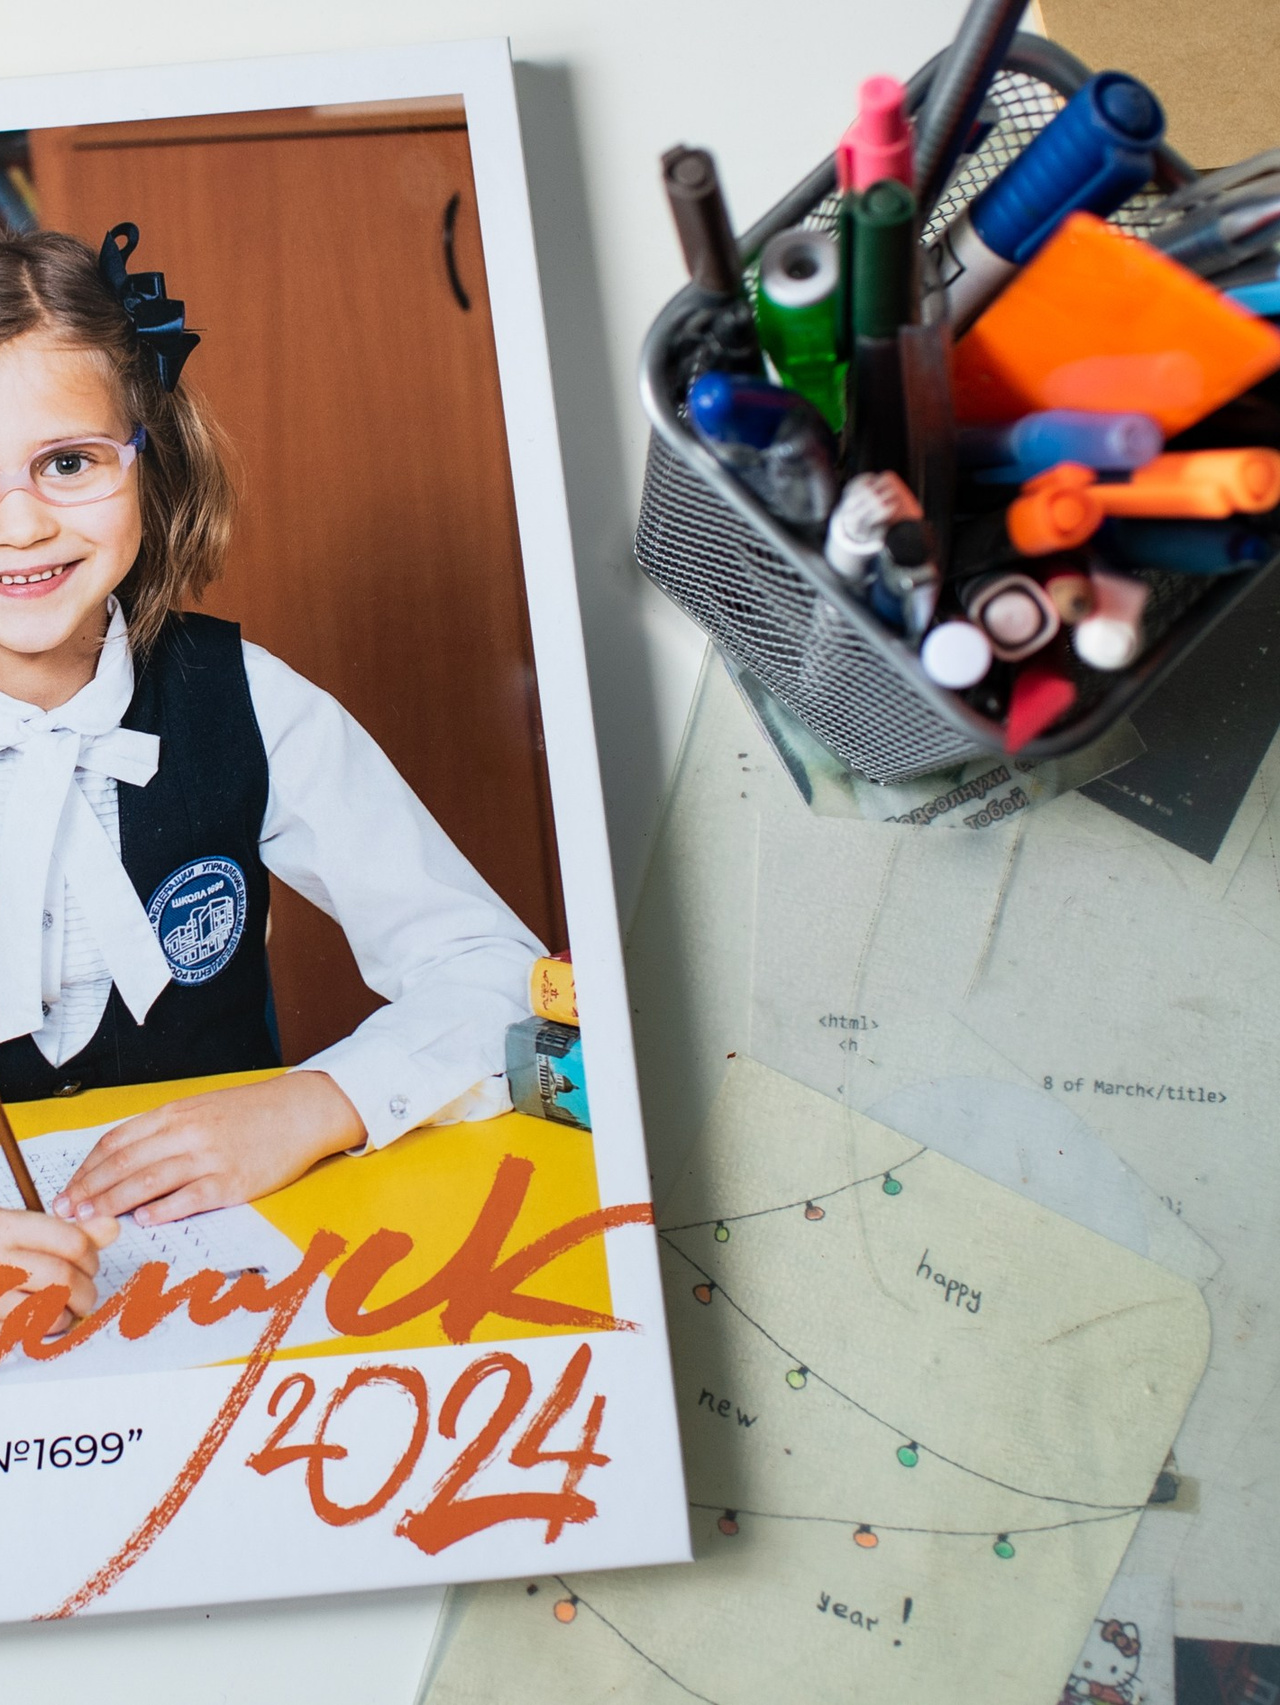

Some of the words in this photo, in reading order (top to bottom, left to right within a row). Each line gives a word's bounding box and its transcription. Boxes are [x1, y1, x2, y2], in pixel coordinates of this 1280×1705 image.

[963, 786, 1030, 830] тобой
[171, 888, 207, 909] ШКОЛА
[818, 1013, 879, 1031] <html>
[1043, 1075, 1054, 1090] 8
[1063, 1077, 1085, 1093] of
[1093, 1079, 1228, 1103] March</title>
[916, 1248, 982, 1313] happy
[698, 1388, 758, 1428] new
[246, 1343, 610, 1556] 2024
